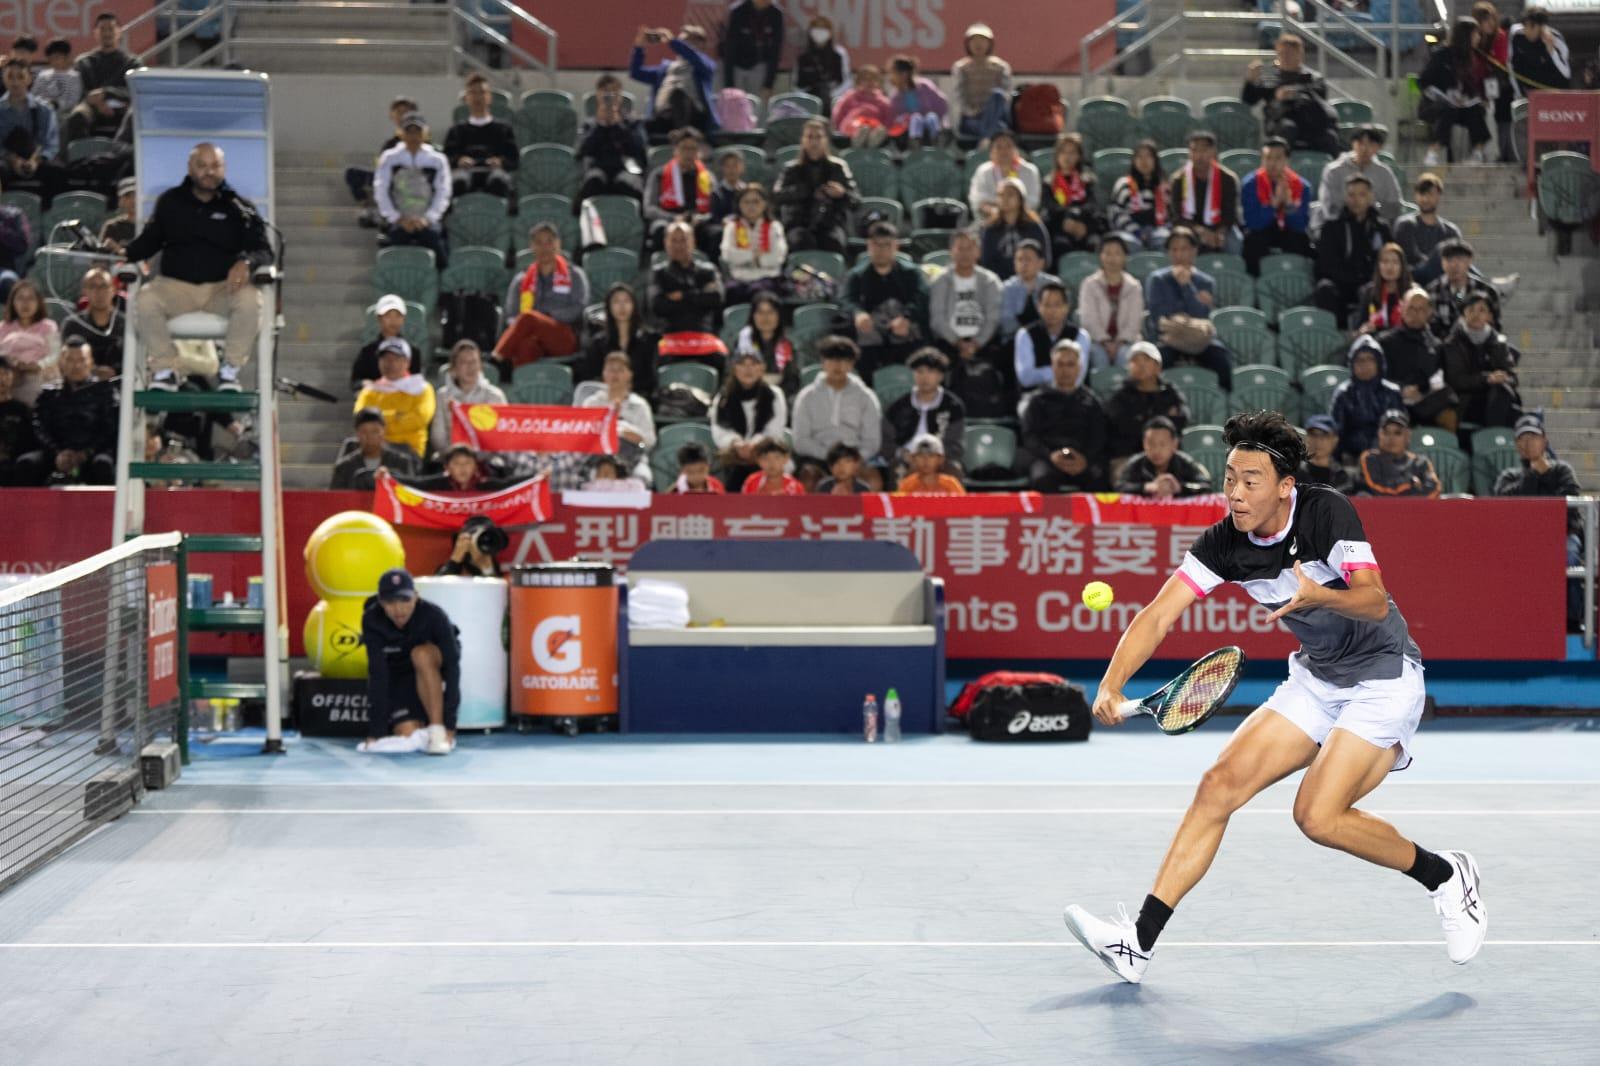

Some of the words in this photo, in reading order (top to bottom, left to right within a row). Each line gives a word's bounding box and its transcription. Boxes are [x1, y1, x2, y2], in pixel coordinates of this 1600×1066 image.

[1538, 110, 1586, 122] SONY
[522, 675, 598, 690] GATORADE
[312, 694, 370, 707] OFFICI
[329, 709, 369, 721] BALL
[1028, 713, 1070, 733] asics
